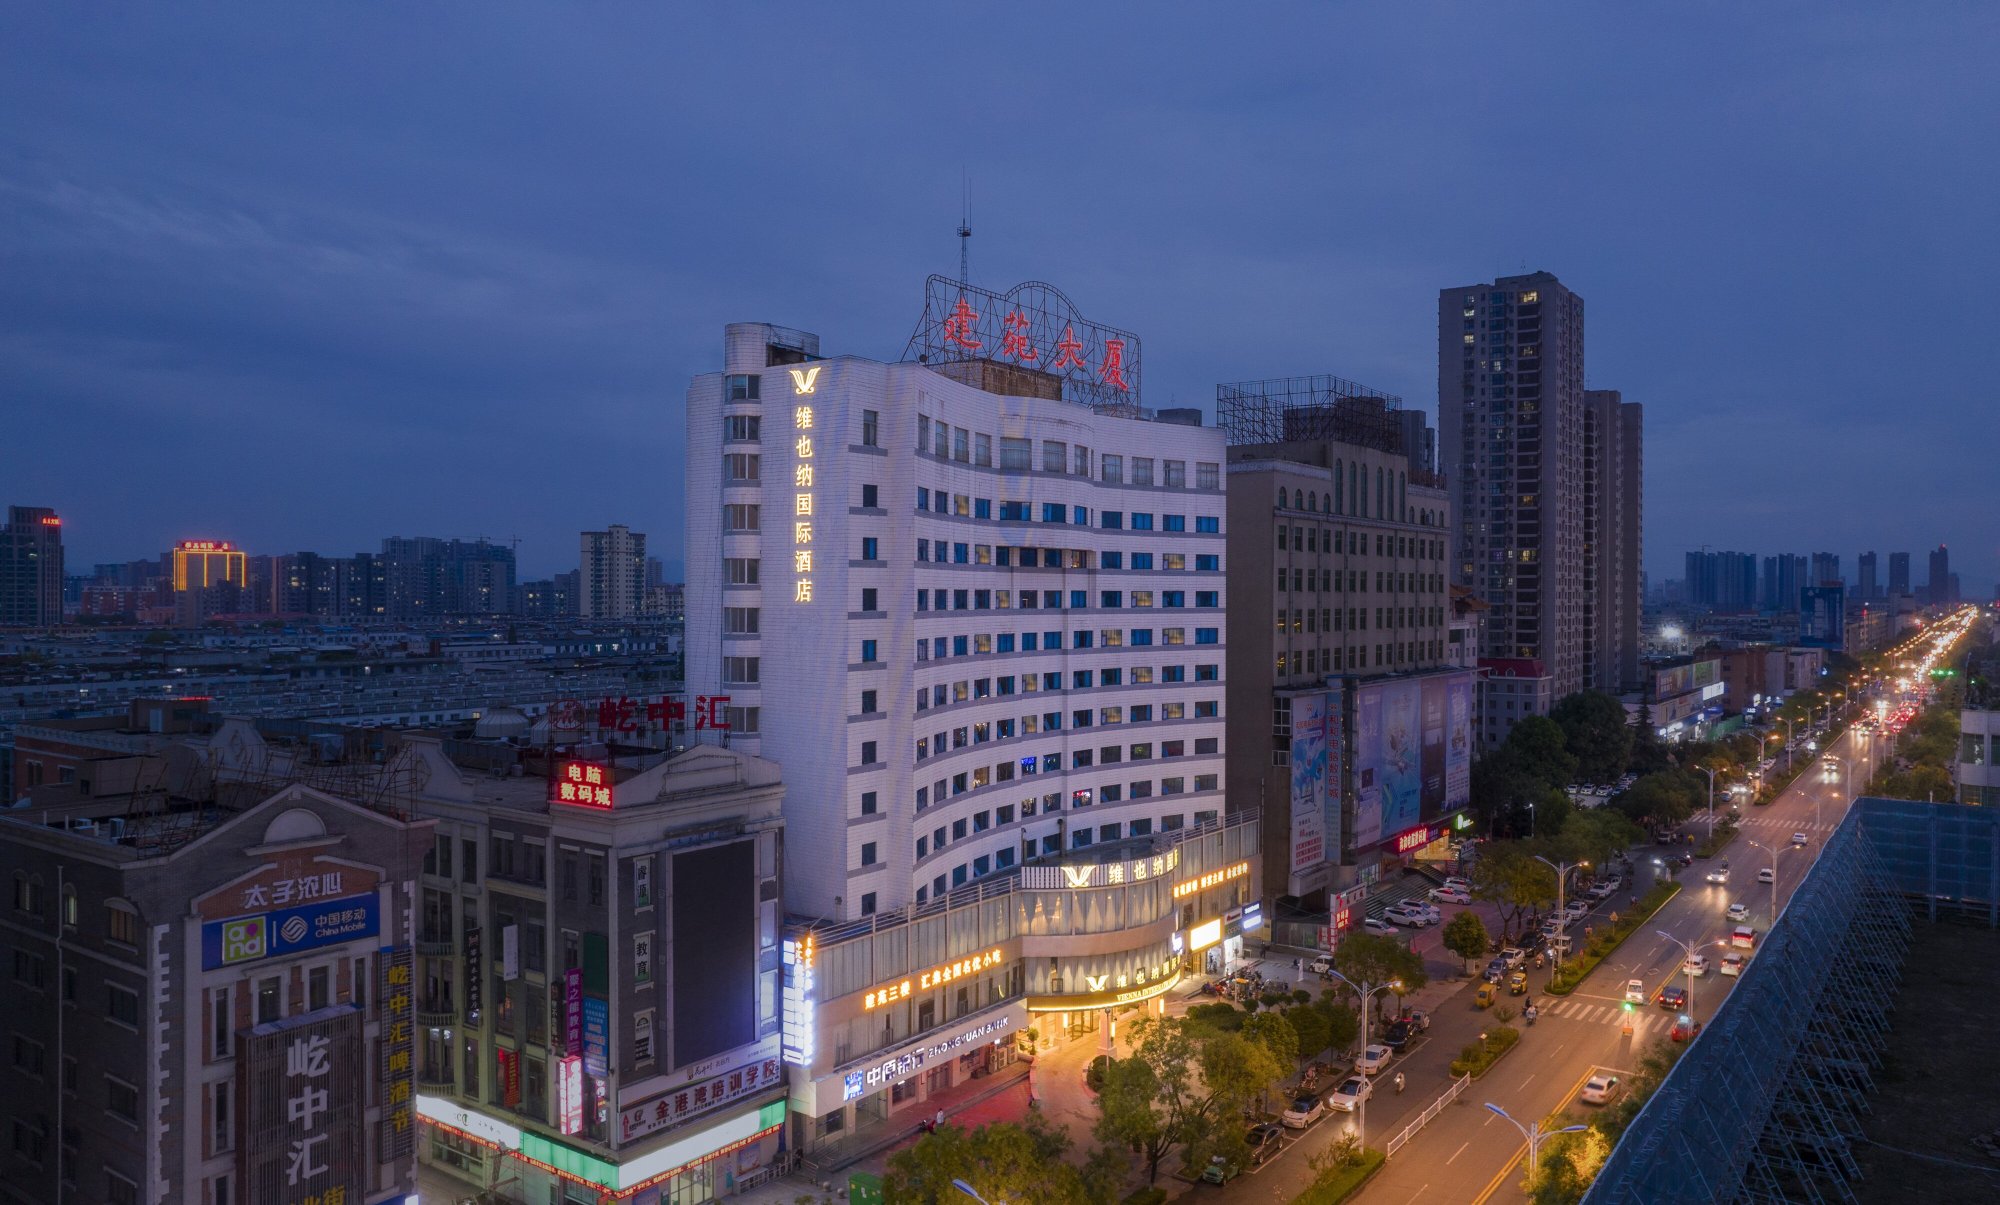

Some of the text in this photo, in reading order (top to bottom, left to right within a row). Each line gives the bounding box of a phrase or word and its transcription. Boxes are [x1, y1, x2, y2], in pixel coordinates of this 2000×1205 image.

[944, 297, 1128, 391] 建苑大厦
[795, 406, 813, 603] 维也纳国际酒店
[600, 696, 731, 731] 屹中汇
[568, 764, 602, 784] 电脑
[561, 782, 611, 806] 数码城
[315, 908, 366, 927] 中国移动
[315, 921, 366, 938] China Mobile
[636, 942, 648, 977] 教育
[1117, 990, 1142, 1002] VIENNA
[387, 965, 409, 1133] 屹中汇啤酒节
[928, 1017, 1008, 1058] ZHONGYUAN BANK
[867, 1047, 925, 1086] 中原银行
[656, 1059, 777, 1121] 金港湾培训学校
[286, 1034, 331, 1186] 屹中汇
